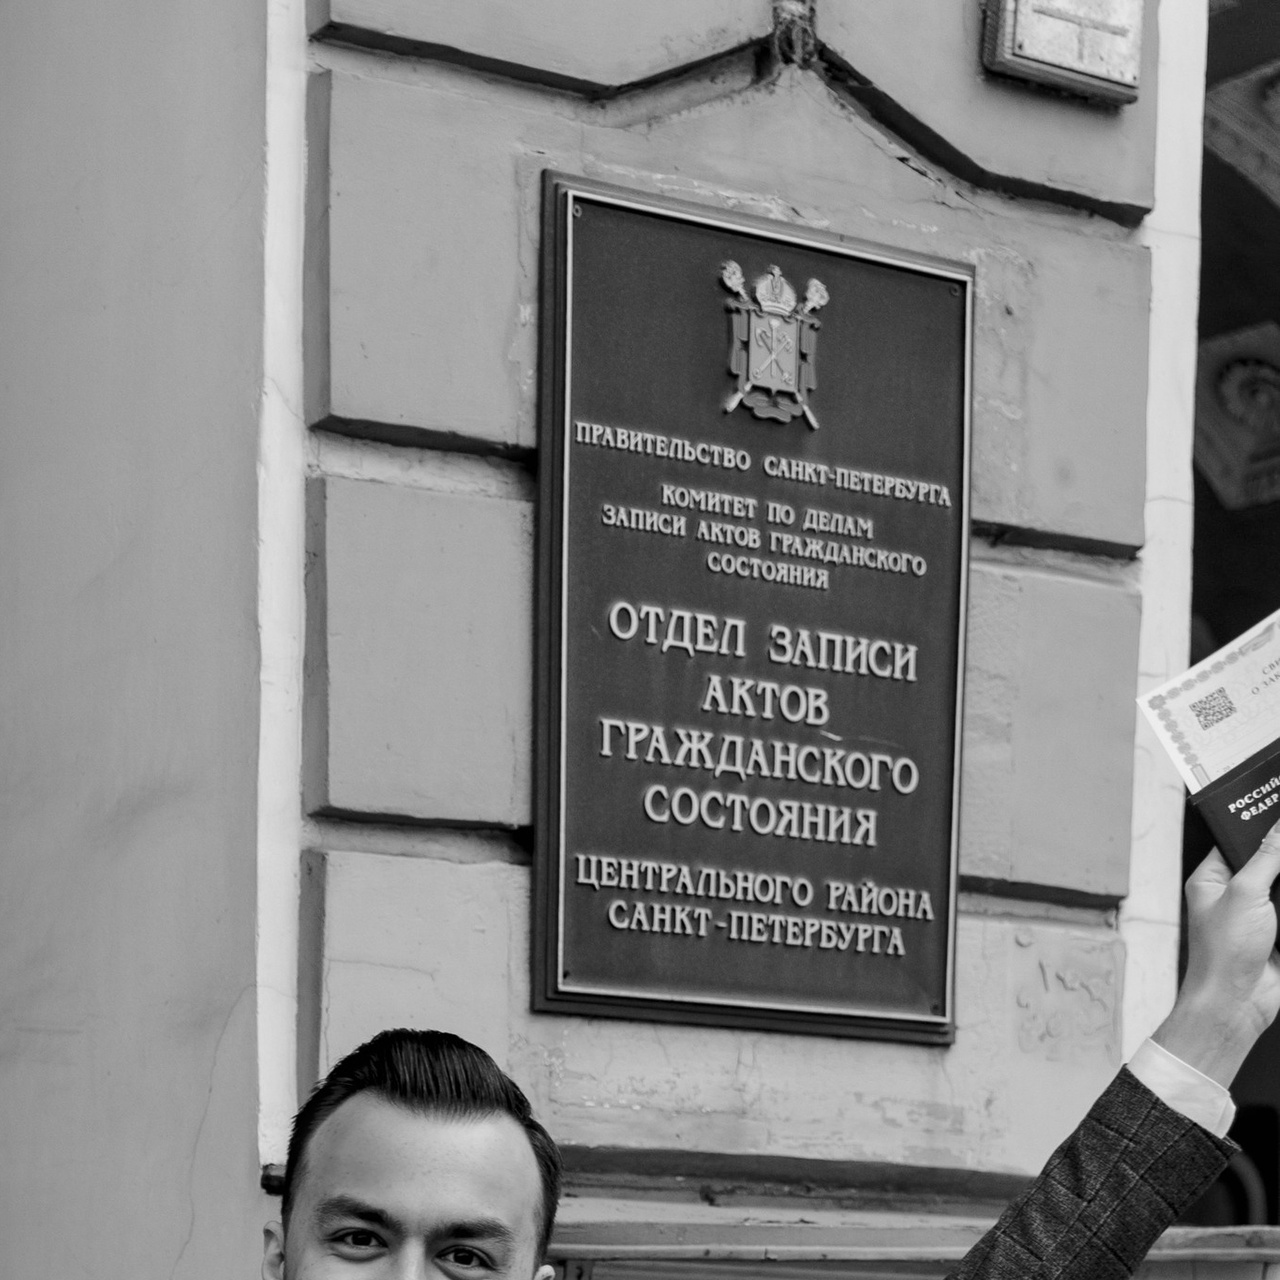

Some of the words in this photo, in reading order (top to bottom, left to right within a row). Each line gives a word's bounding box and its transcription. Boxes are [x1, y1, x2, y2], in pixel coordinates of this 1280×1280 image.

[575, 421, 751, 471] ПРАВИТЕЛЬСТВО
[764, 455, 951, 506] САНКТ-ПЕТЕРБУРГА
[602, 504, 686, 536] ЗАПИСИ
[697, 520, 761, 548] АКТОВ
[770, 531, 927, 577] ГРАЖДАНСКОГО
[662, 484, 757, 518] КОМИТЕТ
[767, 502, 795, 525] ПО
[803, 508, 874, 539] ДЕЛАМ
[707, 552, 829, 589] СОСТОЯНИЯ
[609, 601, 747, 657] ОТДЕЛ
[769, 625, 918, 681] ЗАПИСИ
[702, 675, 830, 726] АКТОВ
[599, 717, 919, 795] ГРАЖДАНСКОГО
[644, 785, 877, 847] СОСТОЯНИЯ
[1228, 774, 1280, 814] РОССИЙ
[575, 854, 813, 907] ЦЕНТРАЛЬНОГО
[827, 880, 935, 921] РАЙОНА
